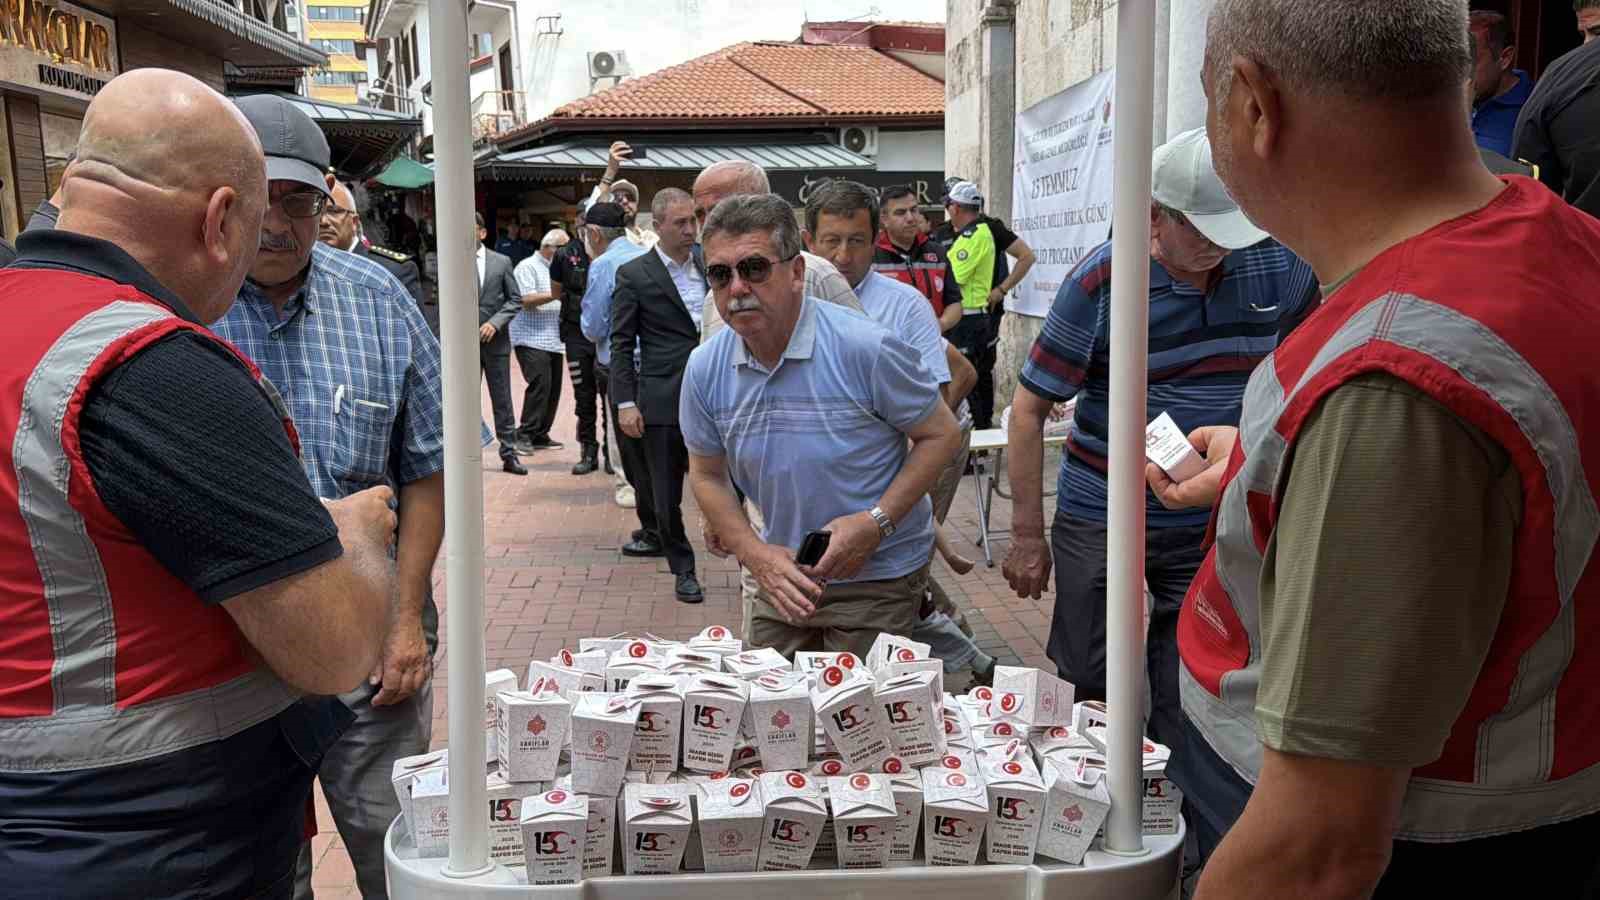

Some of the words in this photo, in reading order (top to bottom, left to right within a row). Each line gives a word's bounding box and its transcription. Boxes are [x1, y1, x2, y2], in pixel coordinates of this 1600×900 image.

[1040, 167, 1078, 197] TEMMUZ
[694, 704, 716, 727] 15
[832, 704, 860, 732] 15
[884, 701, 911, 724] 15
[489, 799, 513, 821] 15
[997, 796, 1019, 819] 15
[771, 818, 795, 841] 15
[847, 825, 869, 842] 15
[935, 815, 957, 836] 15
[535, 831, 560, 854] 15
[636, 831, 658, 851] 15
